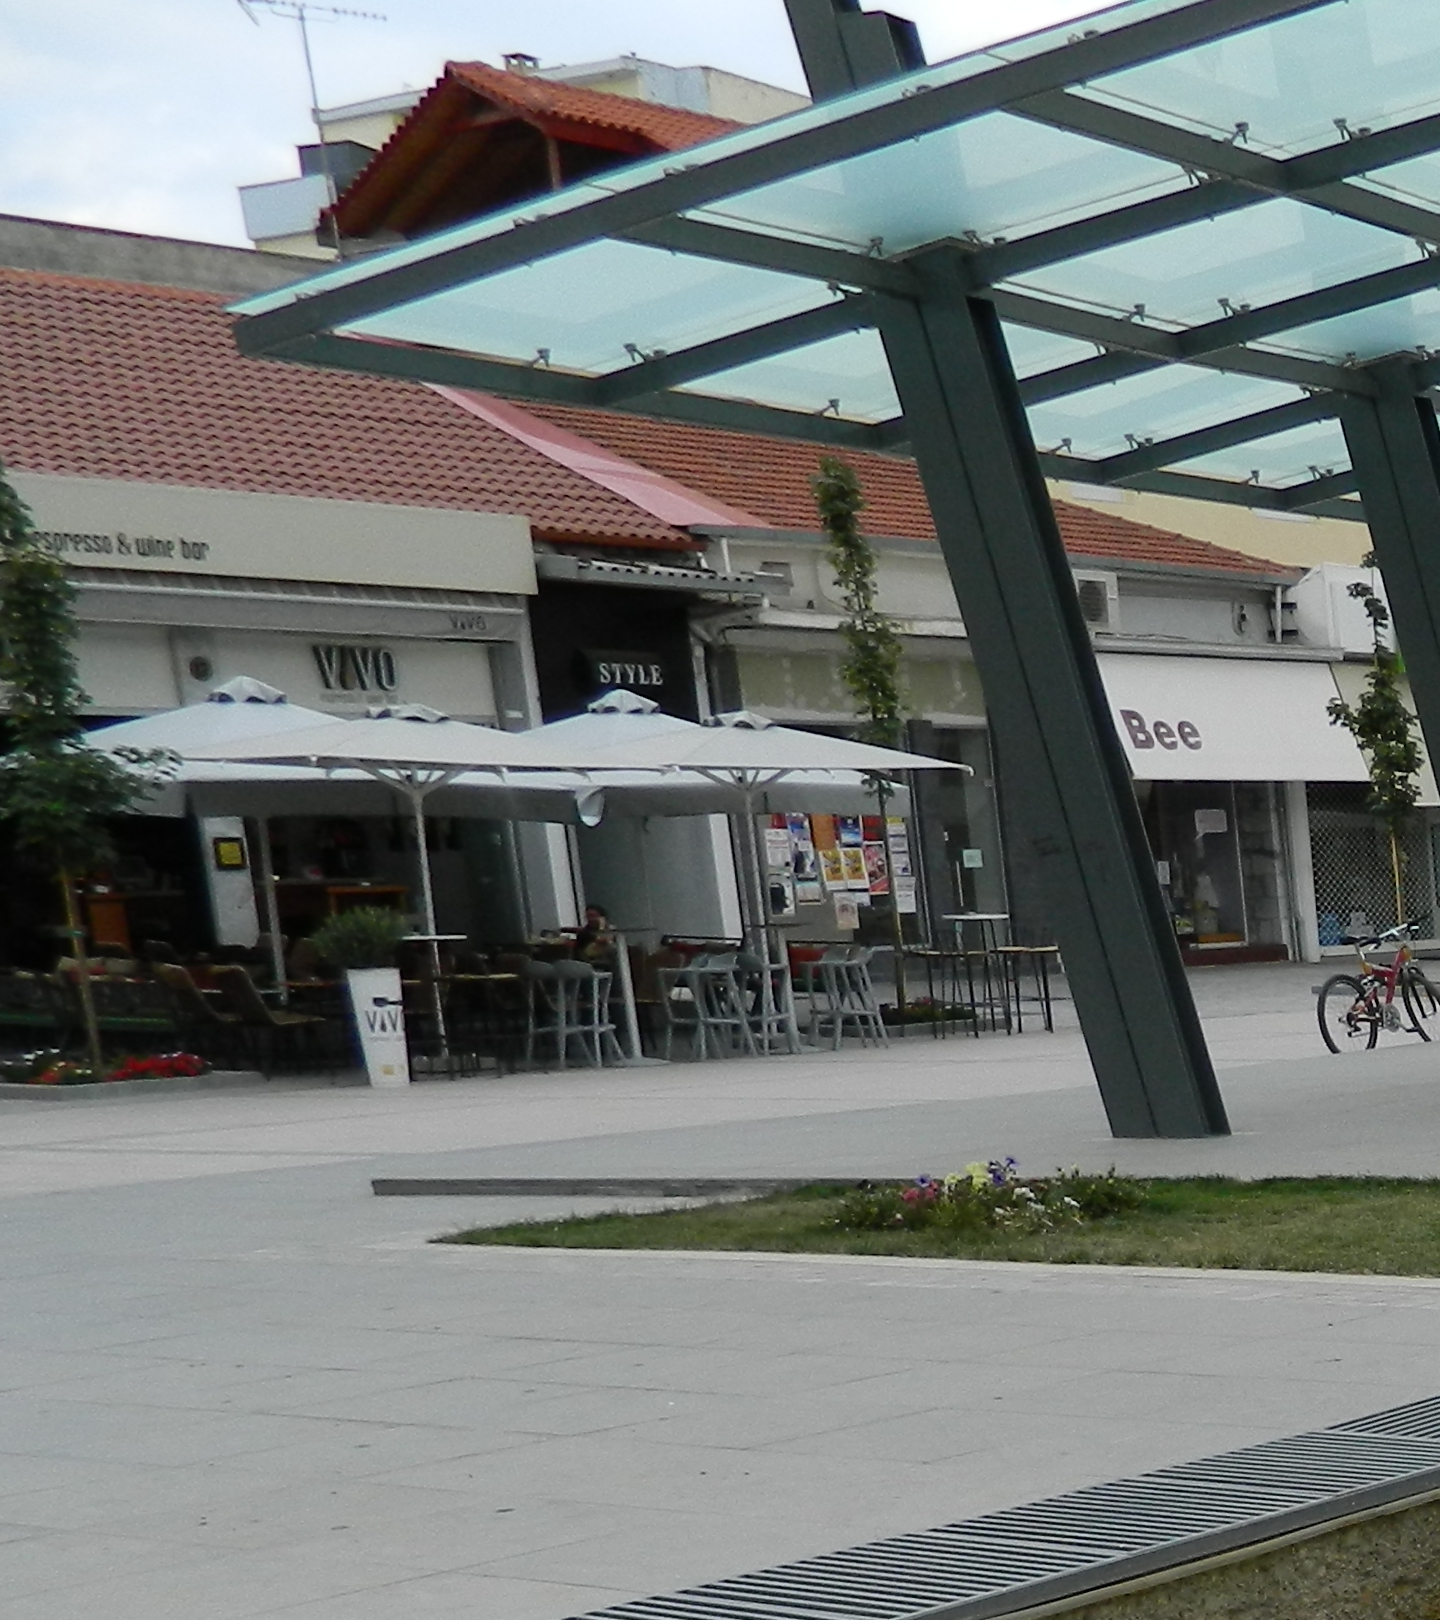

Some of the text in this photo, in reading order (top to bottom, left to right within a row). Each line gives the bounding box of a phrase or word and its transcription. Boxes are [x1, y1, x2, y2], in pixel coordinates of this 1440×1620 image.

[32, 531, 210, 561] espresso & wine bar
[312, 645, 398, 691] VIVO
[599, 663, 663, 686] STYLE
[1119, 709, 1202, 751] Bee
[365, 1009, 405, 1033] VIV
